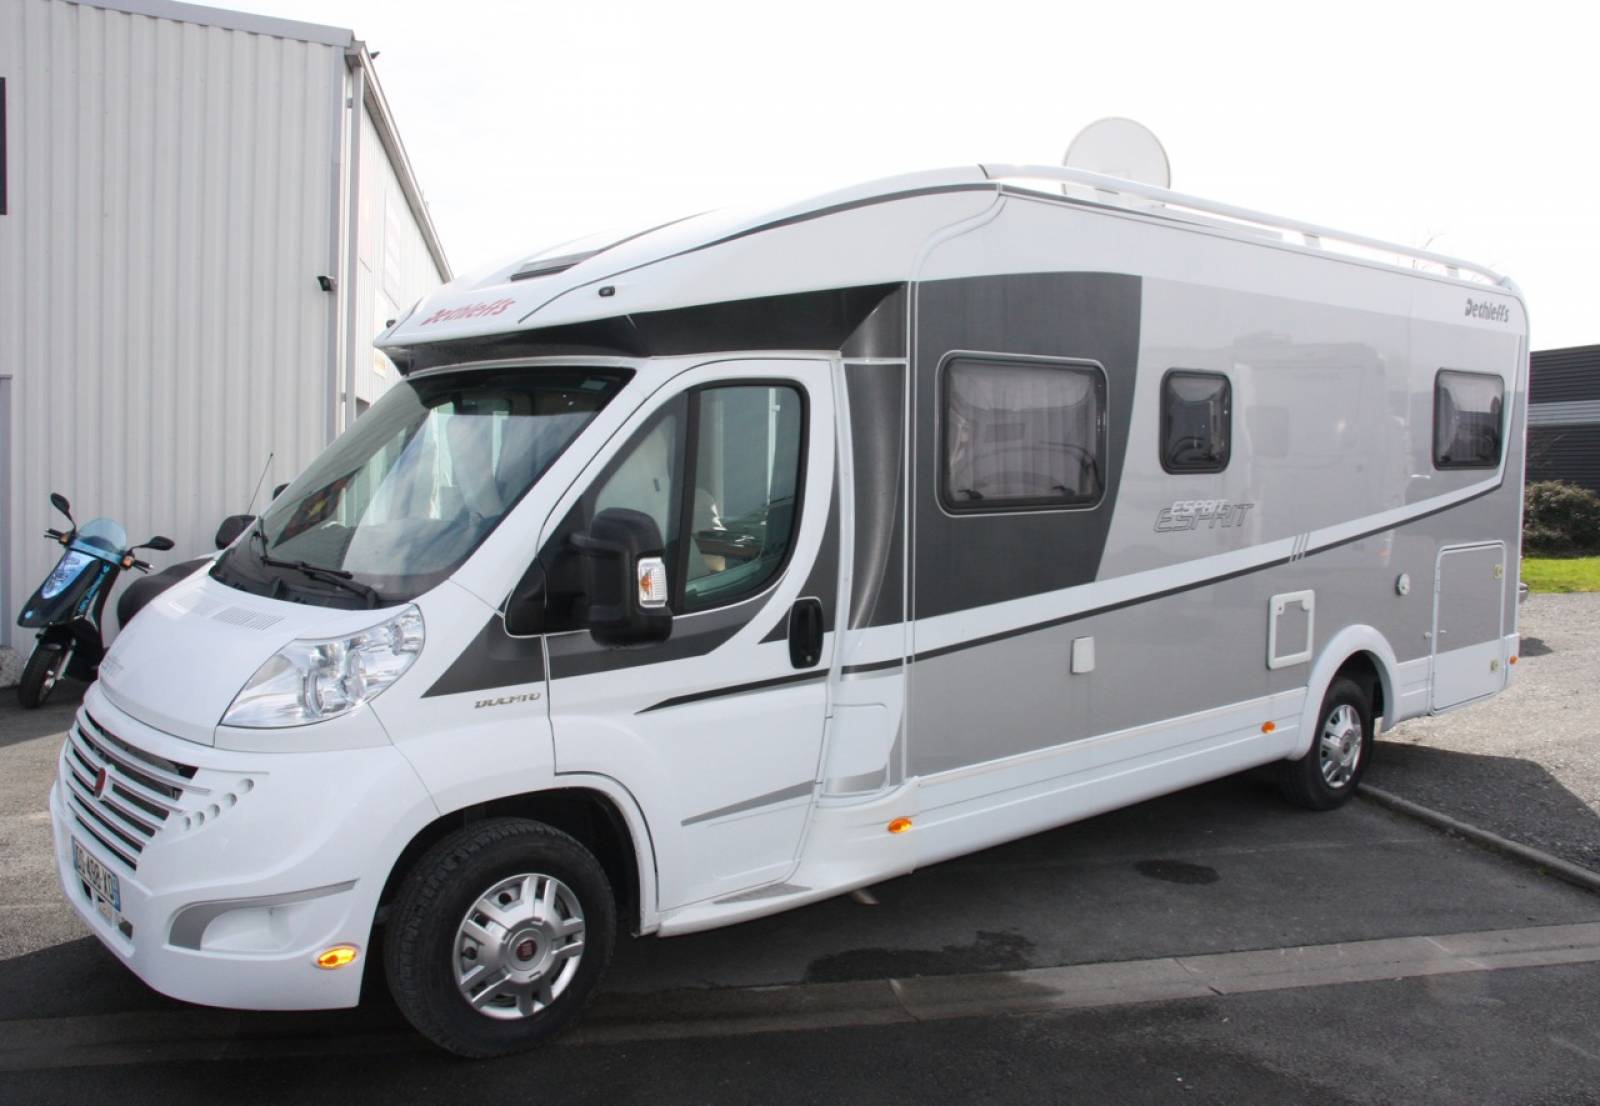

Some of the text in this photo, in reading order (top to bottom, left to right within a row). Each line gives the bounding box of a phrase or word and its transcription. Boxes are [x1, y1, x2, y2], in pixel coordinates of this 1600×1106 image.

[420, 298, 516, 326] Dethleffs
[1465, 298, 1510, 323] Dethleffs
[1170, 499, 1229, 515] ESPRIT
